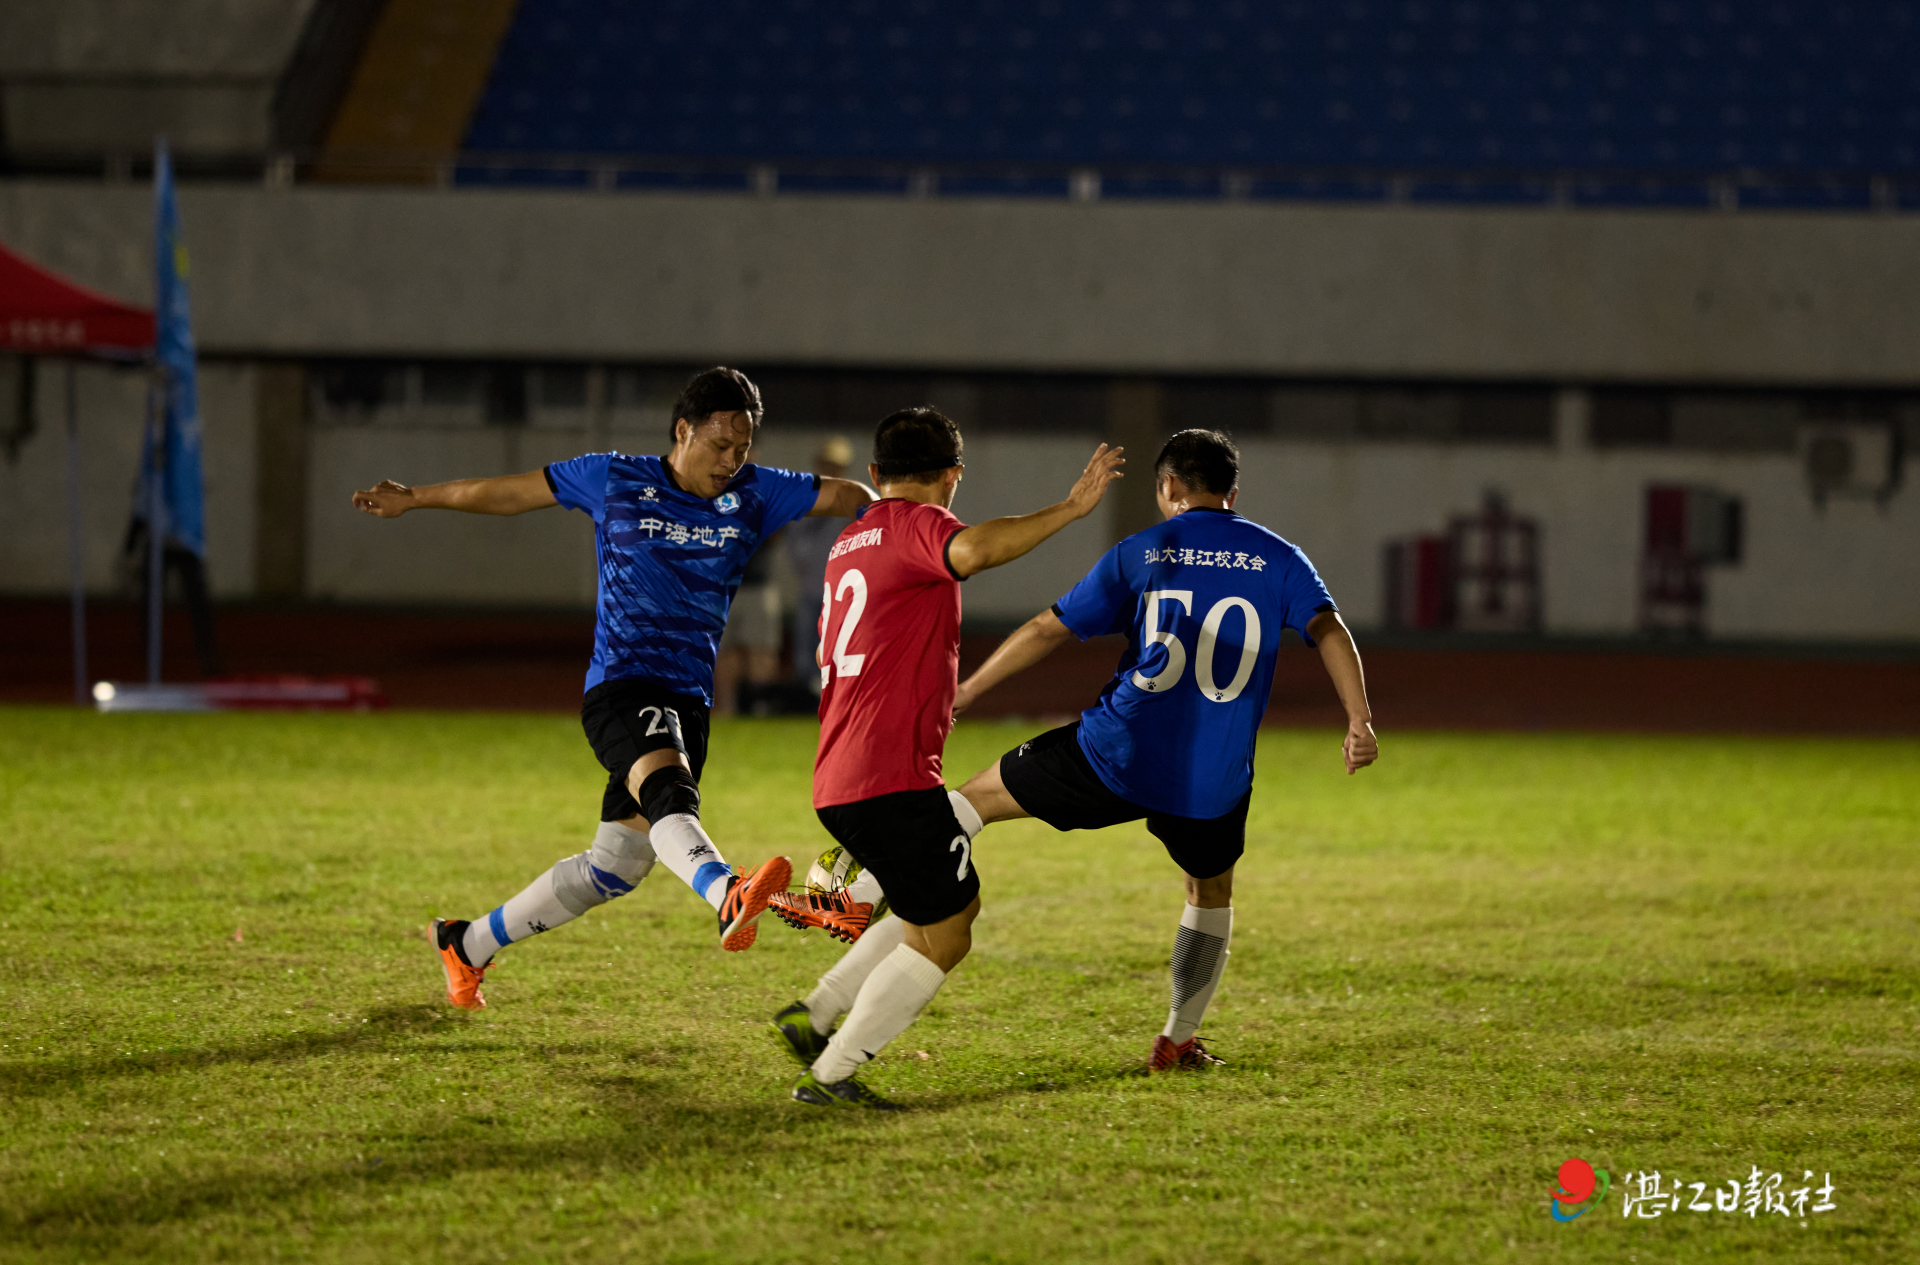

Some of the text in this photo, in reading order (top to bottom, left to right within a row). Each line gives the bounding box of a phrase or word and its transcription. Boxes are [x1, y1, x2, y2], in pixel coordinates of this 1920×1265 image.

[638, 517, 741, 548] 中海地产
[1144, 546, 1268, 572] 汕大湛江校友会
[1130, 589, 1262, 703] 50
